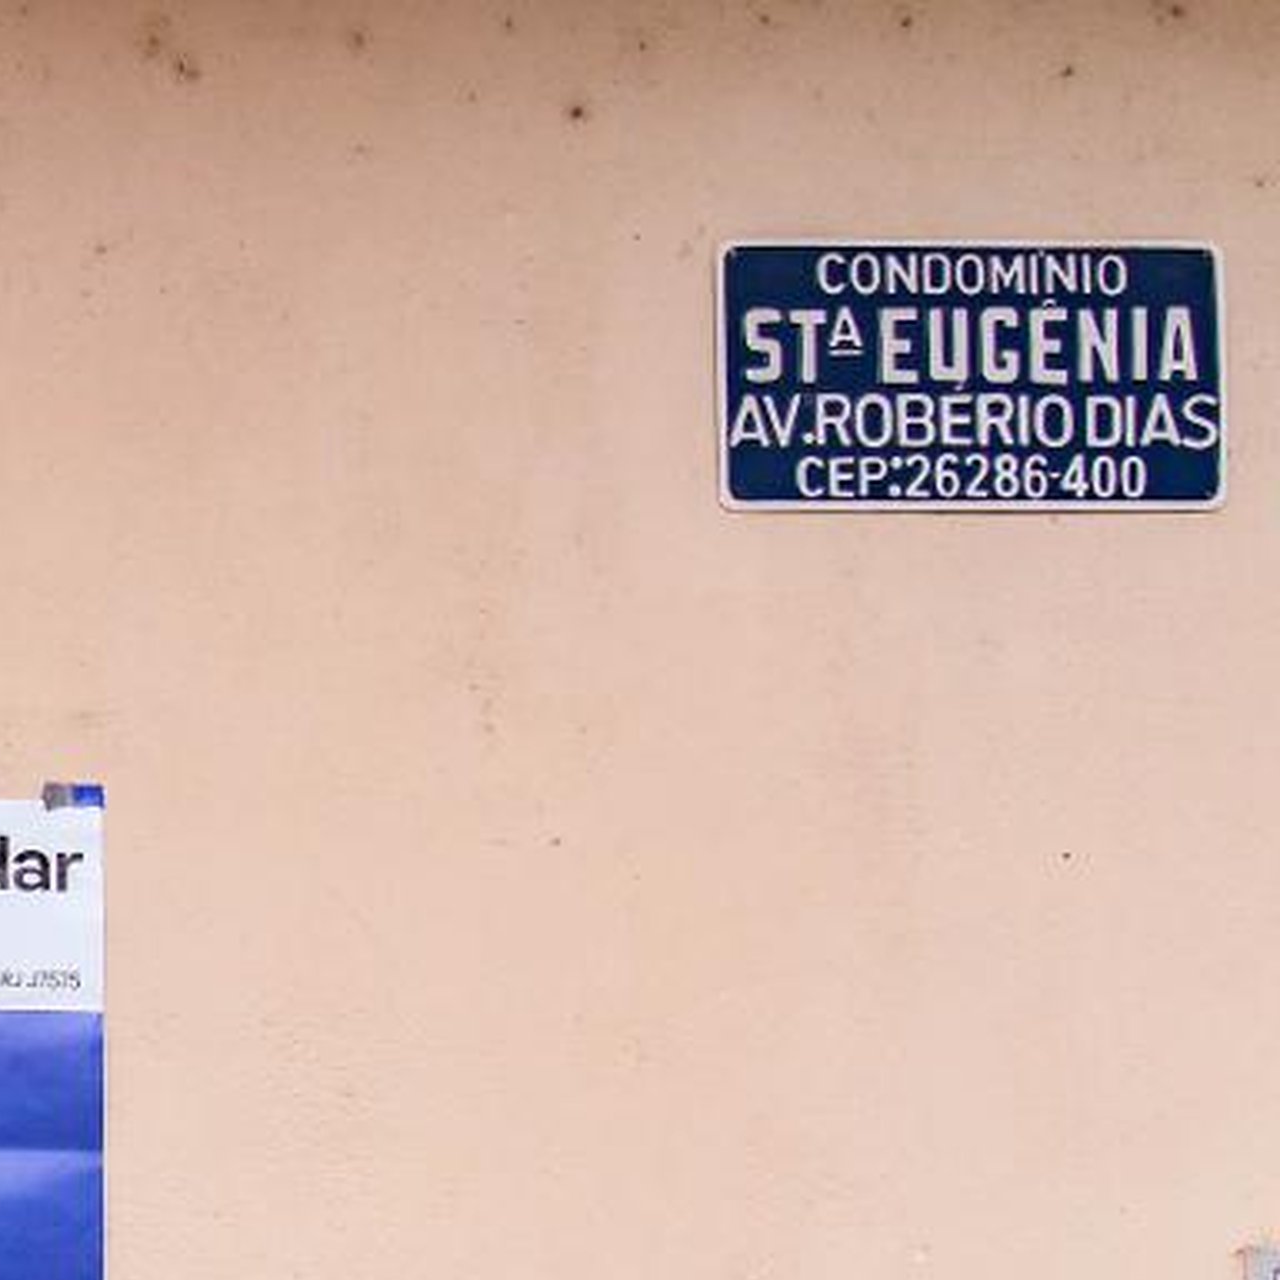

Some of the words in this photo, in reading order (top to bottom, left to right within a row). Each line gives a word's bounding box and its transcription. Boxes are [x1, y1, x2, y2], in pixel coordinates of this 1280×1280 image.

[879, 299, 1198, 384] EUGÊNIA
[1086, 393, 1220, 450] DIAS
[796, 454, 1148, 499] CEP:26286-400
